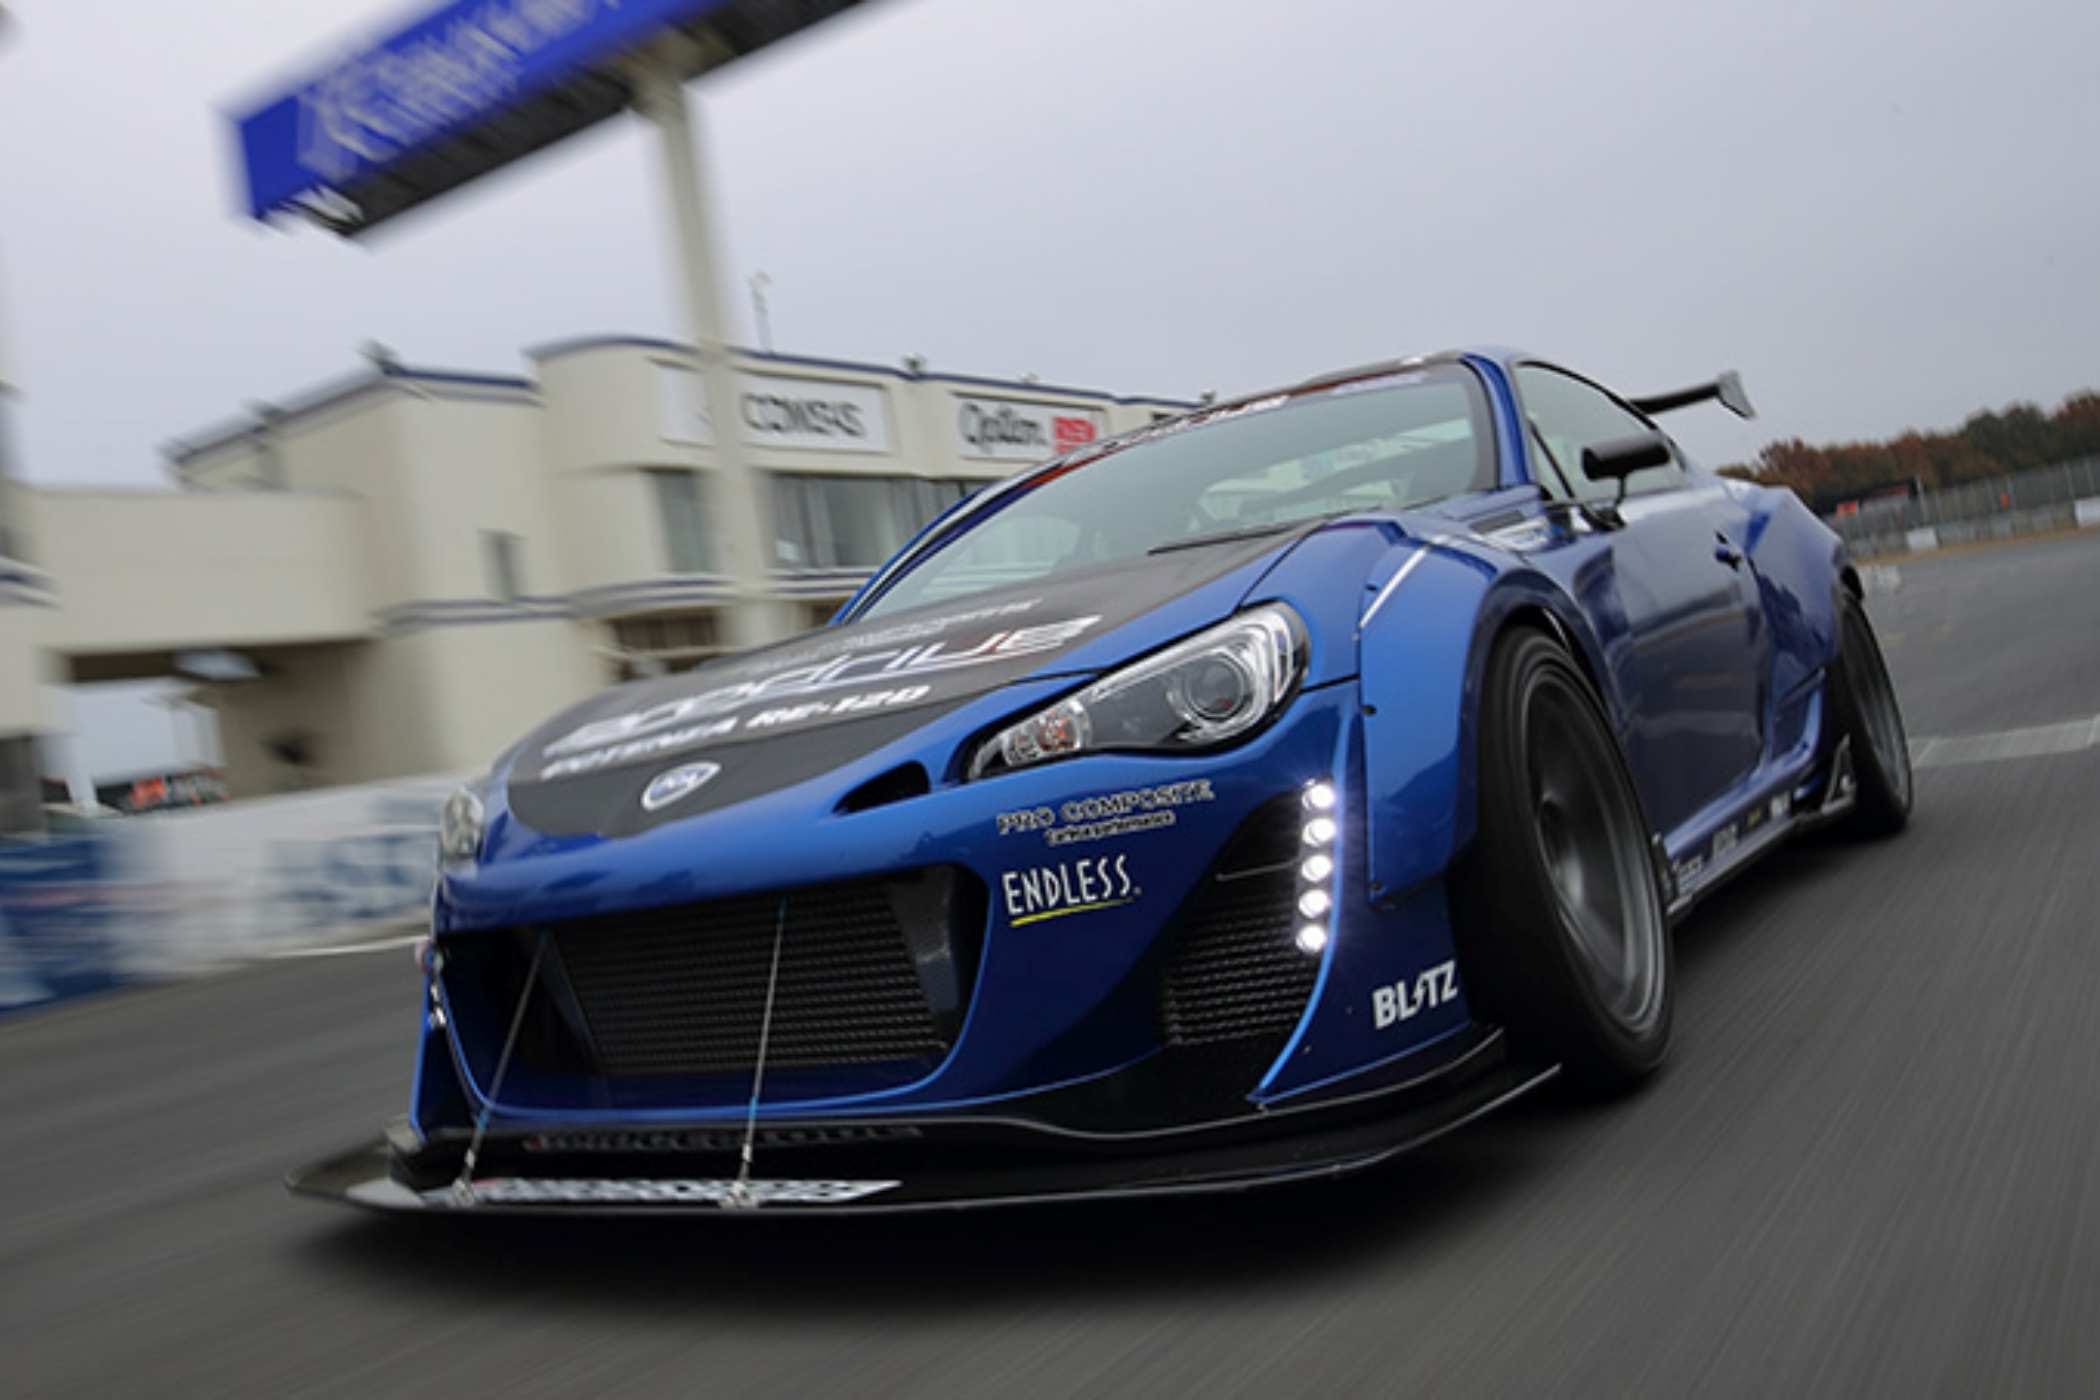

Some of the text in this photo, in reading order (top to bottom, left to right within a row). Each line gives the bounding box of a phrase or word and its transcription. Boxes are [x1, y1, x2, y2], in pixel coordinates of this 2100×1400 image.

[996, 778, 1214, 835] PRO COMPOSITE
[1002, 854, 1131, 916] ENDLESS
[1373, 960, 1458, 1029] BLITZ
